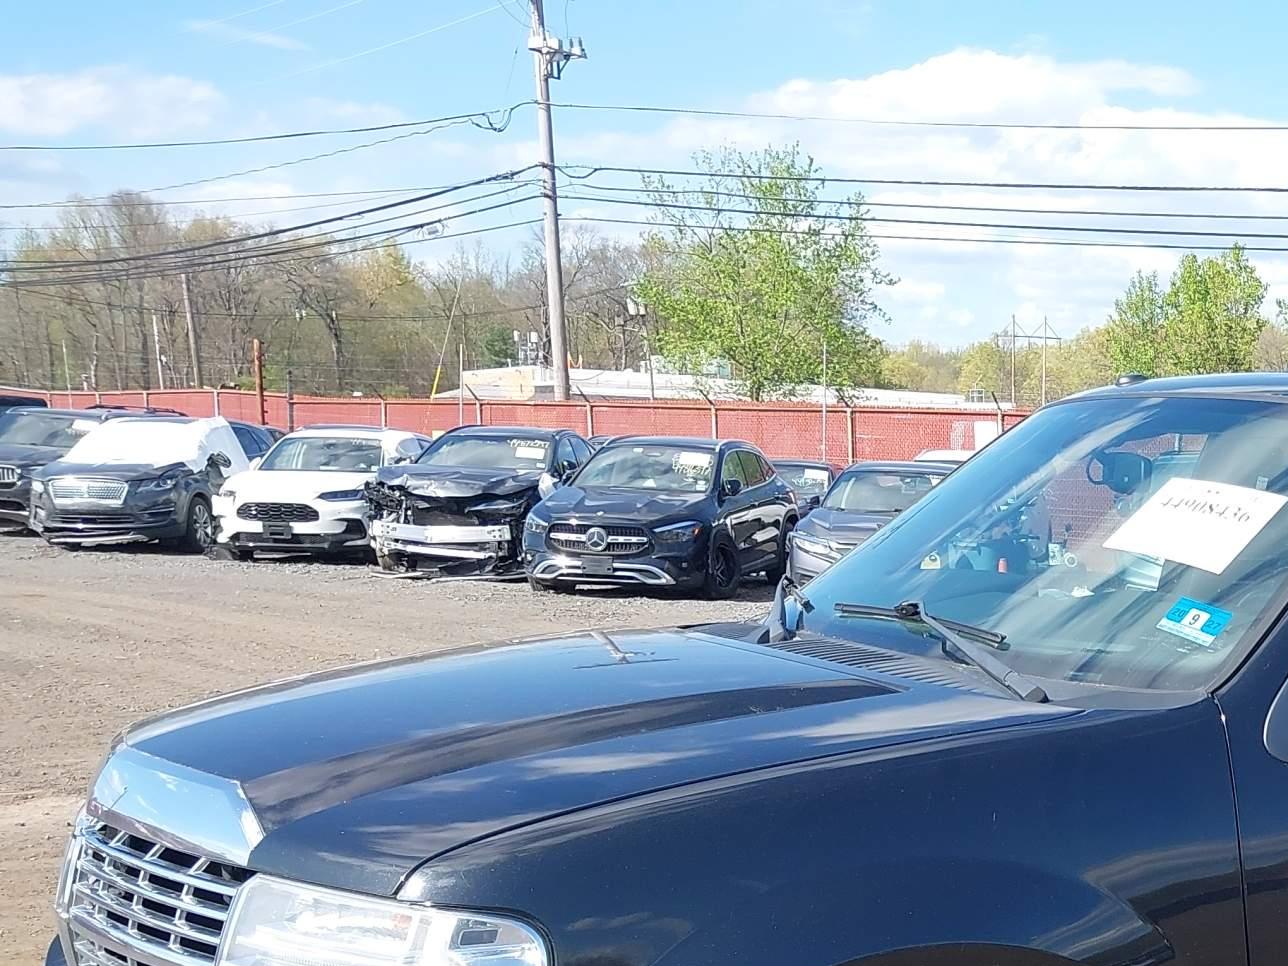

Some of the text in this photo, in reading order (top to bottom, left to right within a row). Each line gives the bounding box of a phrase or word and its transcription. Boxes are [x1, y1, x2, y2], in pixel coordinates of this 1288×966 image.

[1172, 607, 1222, 630] 20 9 27
